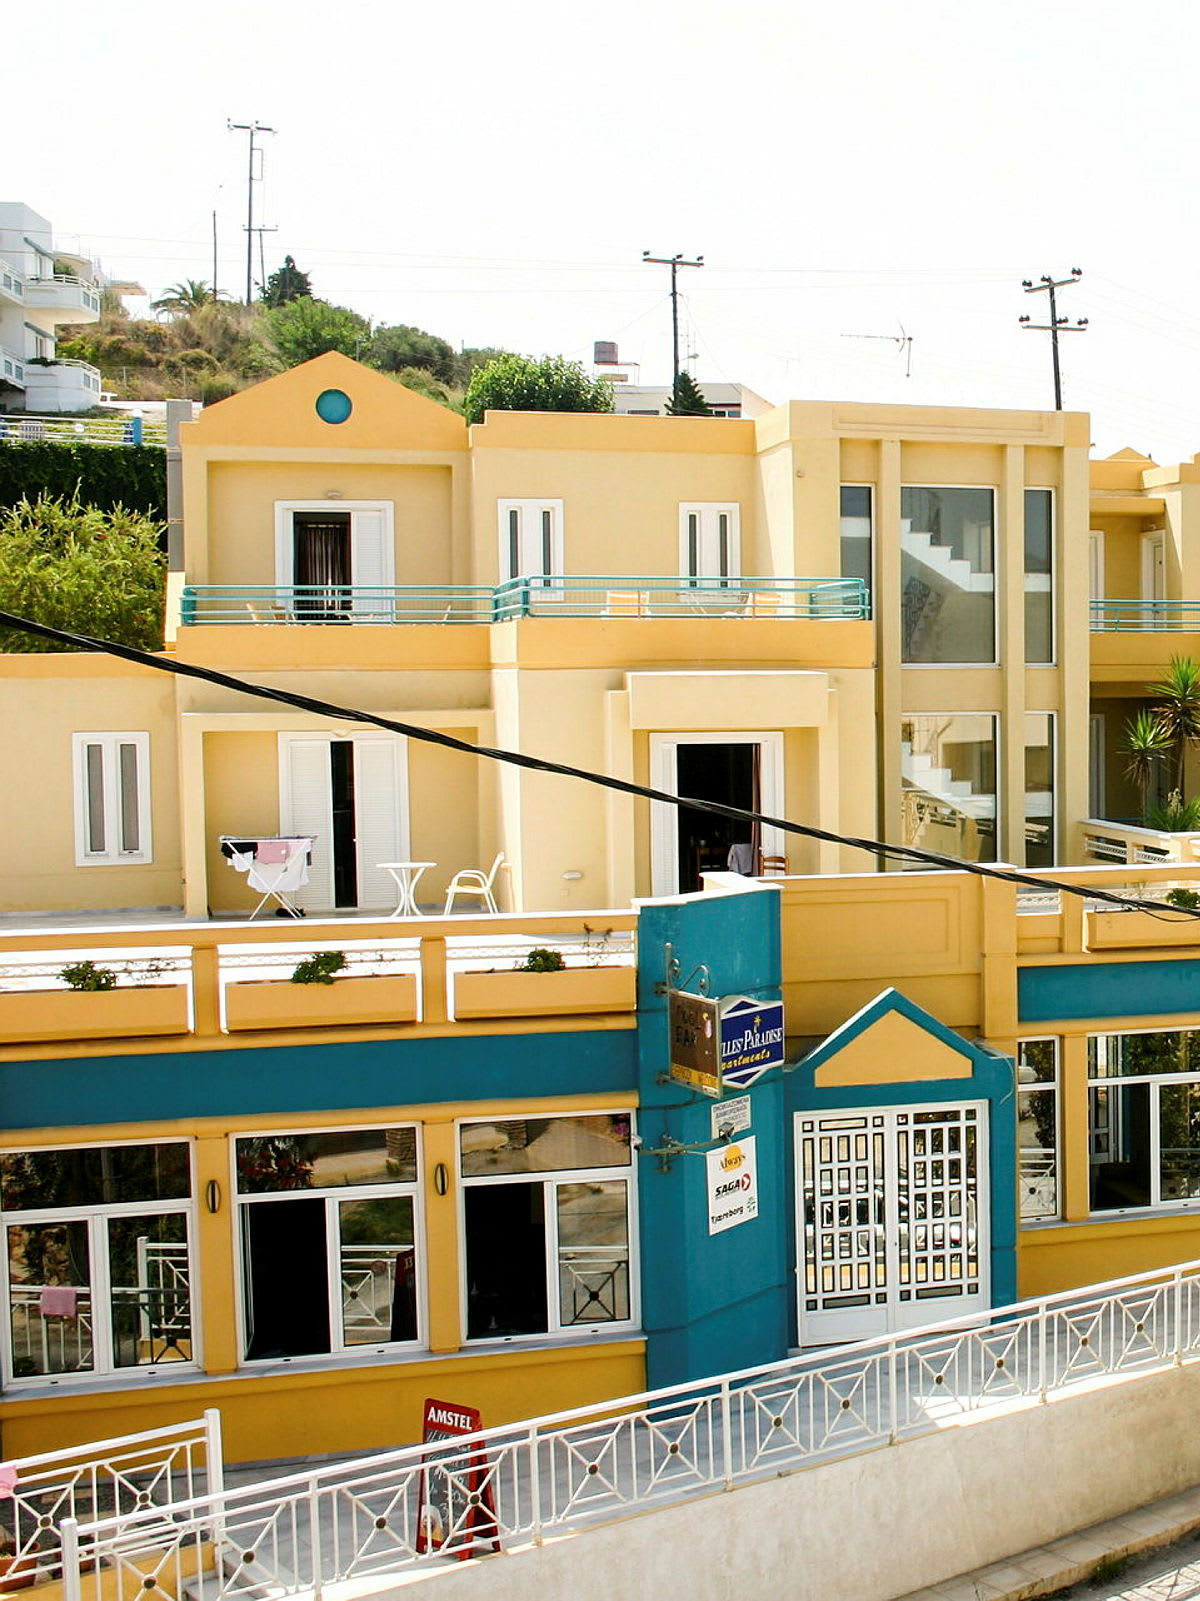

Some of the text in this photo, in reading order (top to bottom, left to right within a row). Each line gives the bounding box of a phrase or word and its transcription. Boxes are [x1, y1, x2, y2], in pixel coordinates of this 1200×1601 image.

[743, 1027, 783, 1051] PARADISE
[719, 1154, 746, 1169] Always
[715, 1178, 740, 1197] SAGA
[427, 1406, 473, 1430] AMSTEL
